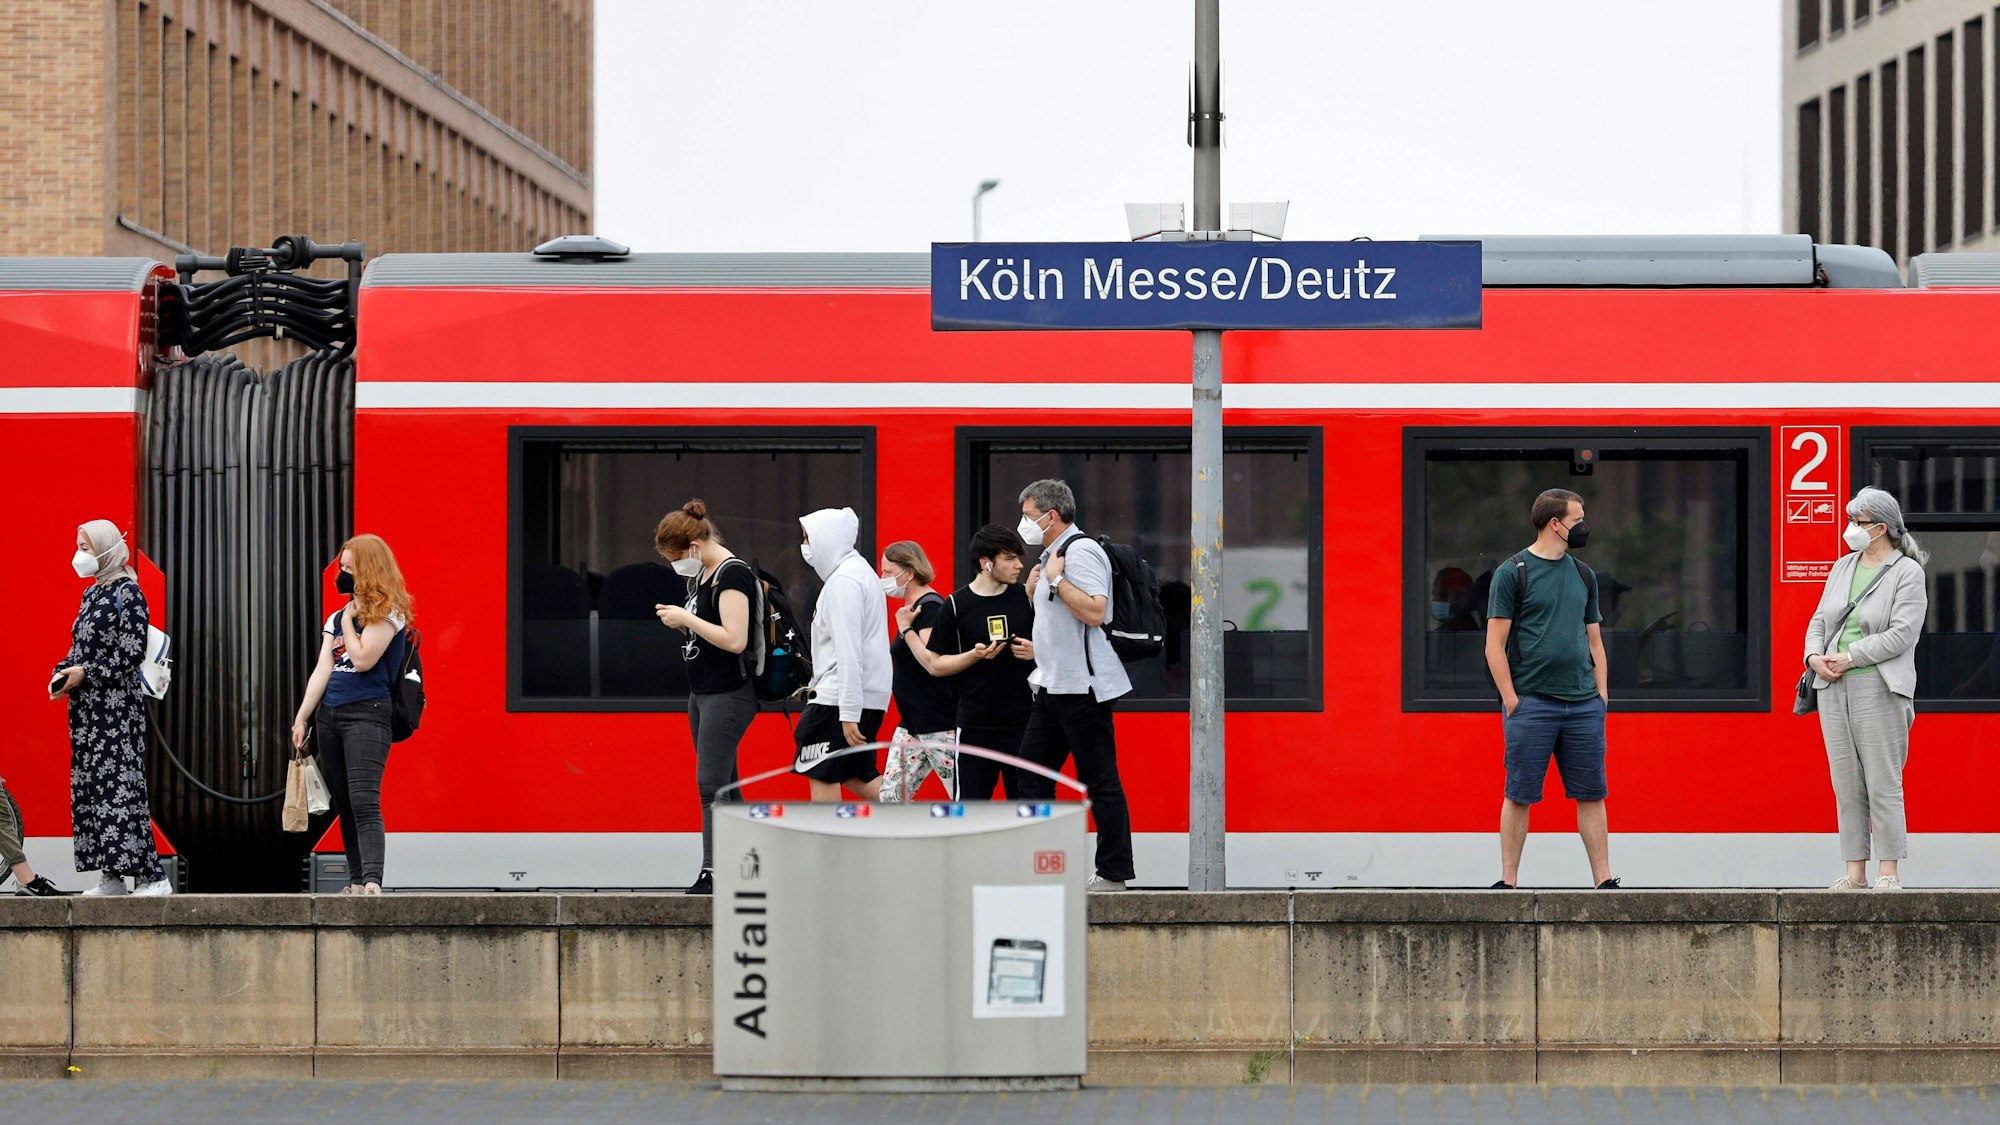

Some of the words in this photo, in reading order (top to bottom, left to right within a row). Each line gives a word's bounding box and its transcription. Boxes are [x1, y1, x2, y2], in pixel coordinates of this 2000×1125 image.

[960, 258, 1064, 301] Köln
[1084, 257, 1397, 301] Messe/Deutz
[1790, 431, 1828, 491] 2
[800, 741, 831, 761] NIKE
[1036, 852, 1063, 873] DB
[734, 891, 767, 1040] Abfall
